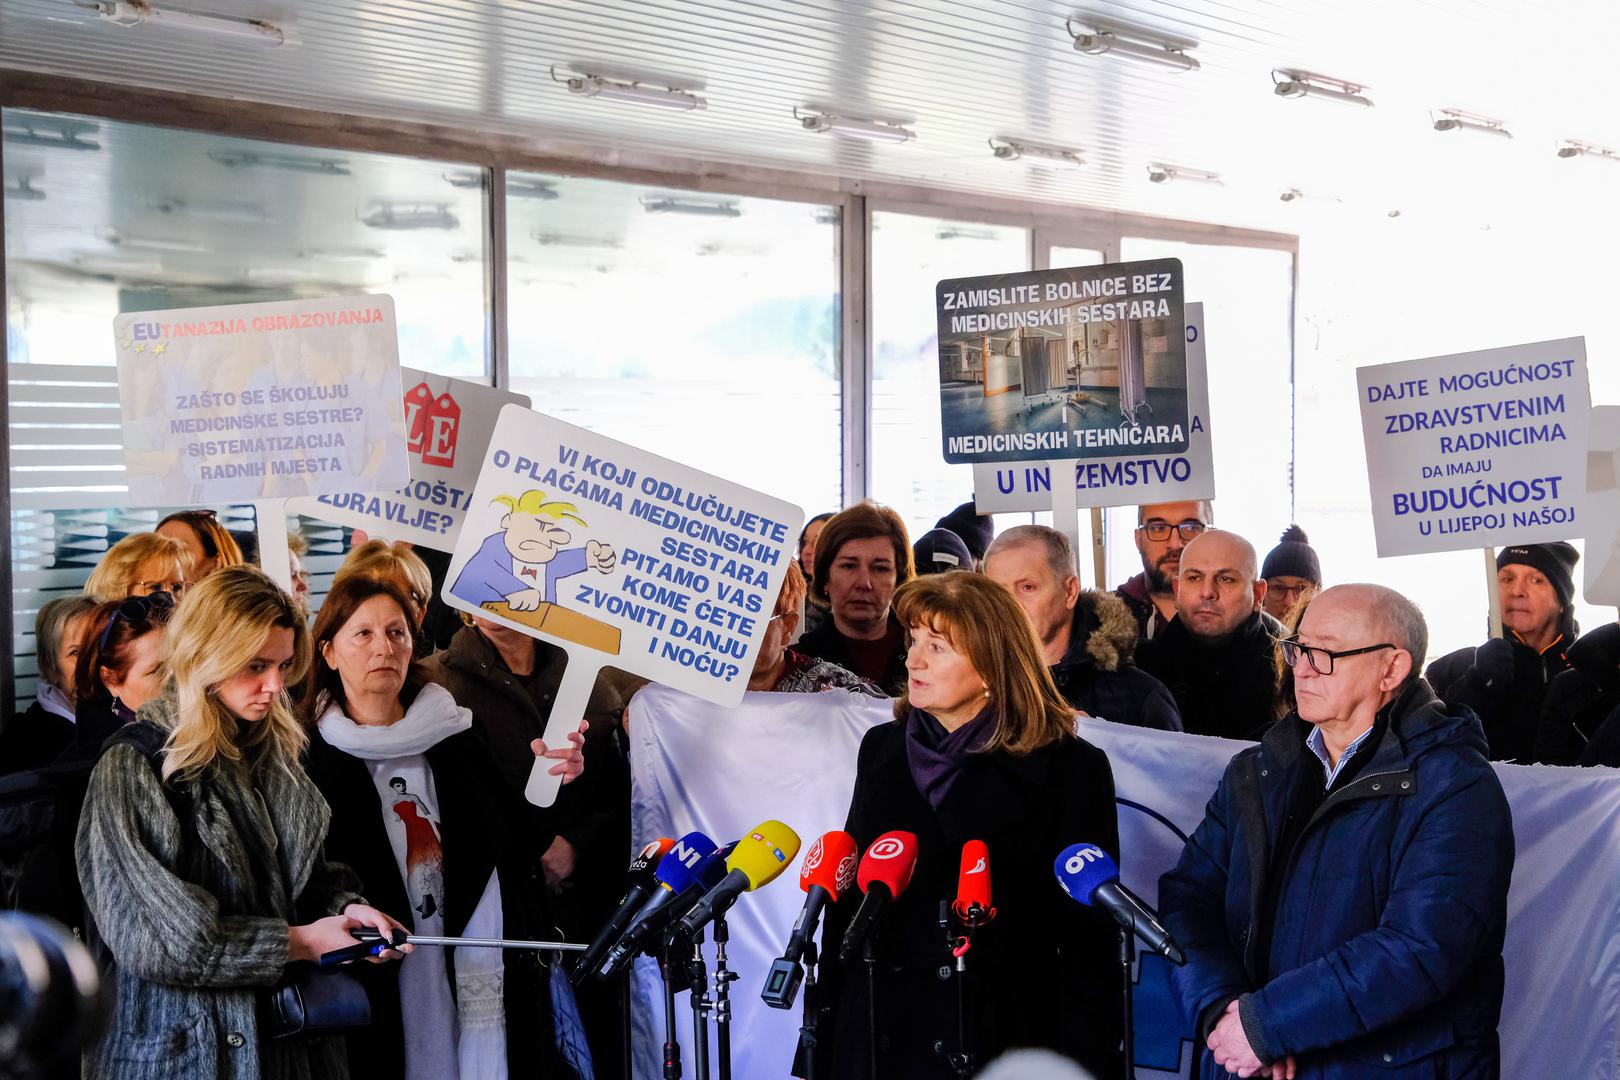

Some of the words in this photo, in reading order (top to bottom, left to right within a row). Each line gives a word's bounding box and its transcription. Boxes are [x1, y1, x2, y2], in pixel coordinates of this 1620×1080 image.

[944, 284, 1040, 310] ZAMISLITE
[1046, 276, 1127, 302] BOLNICE
[1132, 273, 1172, 293] BEZ
[133, 318, 247, 342] EUTANAZIJA
[252, 308, 384, 332] OBRAZOVANJA
[952, 307, 1072, 333] MEDICINSKIH
[1077, 298, 1170, 324] SESTARA
[176, 387, 236, 411] ZAŠTO
[241, 388, 265, 406] SE
[269, 382, 349, 404] ŠKOLUJU
[1367, 379, 1430, 403] DAJTE
[1438, 359, 1575, 394] MOGUĆNOST
[170, 413, 278, 435] MEDICINSKE
[283, 406, 363, 427] SESTRE?
[1062, 406, 1067, 424] I
[1385, 394, 1566, 435] ZDRAVSTVENIM
[187, 432, 346, 458] SISTEMATIZACIJA
[949, 431, 1068, 454] MEDICINSKIH
[1073, 423, 1184, 448] TEHNIČARA
[1440, 423, 1567, 454] RADNICIMA
[200, 460, 268, 481] RADNIH
[271, 456, 342, 478] MJESTA
[996, 470, 1015, 495] U
[1026, 456, 1191, 493] INZEMSTVO
[1422, 465, 1443, 479] DA
[1446, 459, 1493, 477] IMAJU
[493, 449, 511, 469] O
[514, 456, 623, 512] PLAĆAMA
[629, 498, 781, 567] MEDICINSKIH
[558, 444, 579, 468] VI
[582, 450, 637, 489] KOJI
[641, 475, 789, 544] ODLUČUJETE
[1392, 476, 1563, 516] BUDUĆNOST
[1419, 520, 1432, 536] U
[1438, 512, 1506, 535] LIJEPOJ
[1513, 506, 1576, 528] NAŠOJ
[620, 547, 710, 593] PITAMO
[716, 582, 763, 613] VAS
[660, 537, 769, 590] SESTARA
[575, 584, 667, 632] ZVONITI
[669, 618, 748, 660] DANJU
[621, 574, 692, 614] KOME
[694, 599, 757, 637] ĆETE
[648, 636, 657, 654] I
[659, 641, 740, 682] NOĆU?
[669, 841, 702, 869] N1
